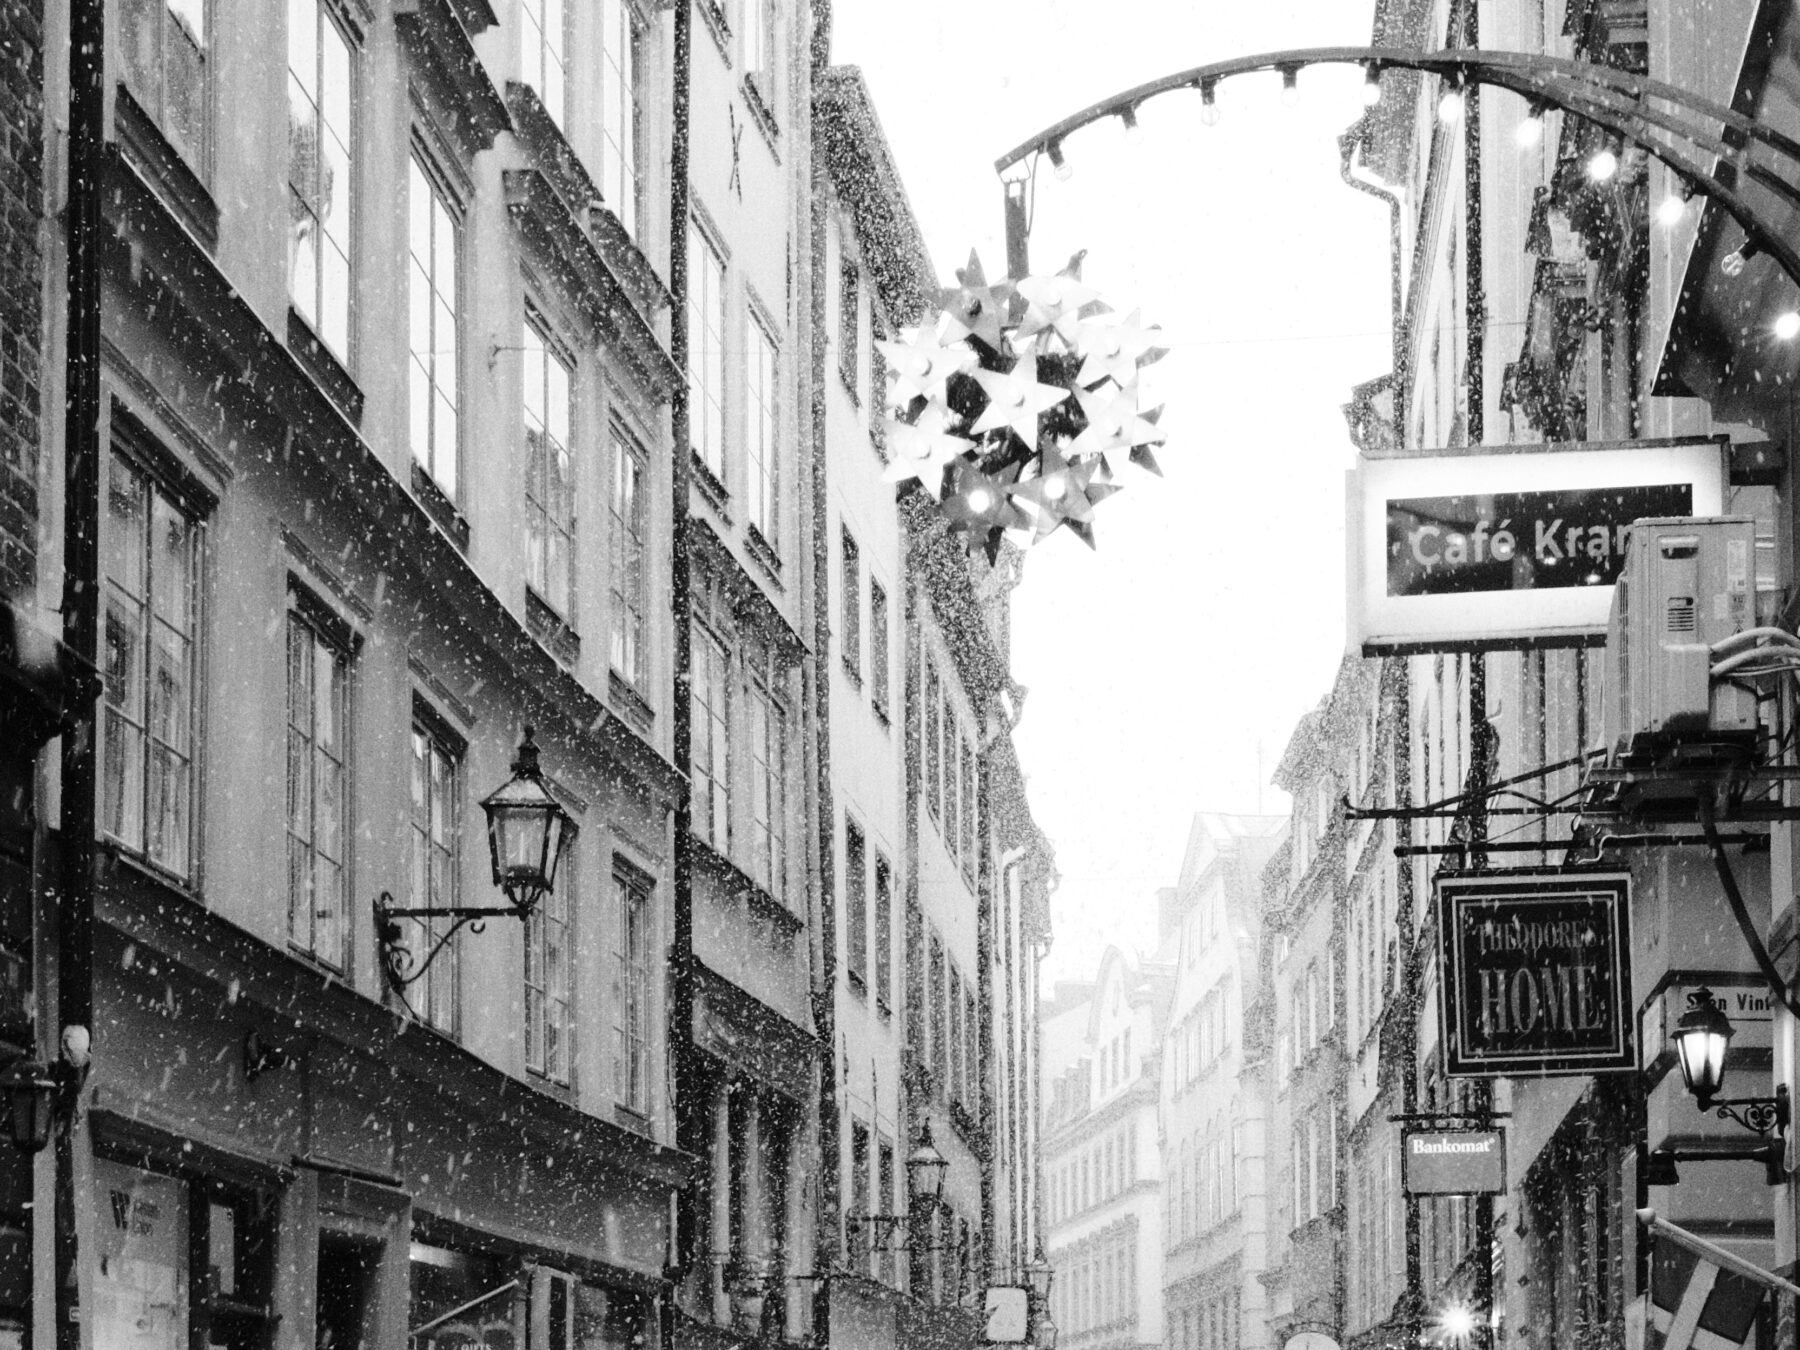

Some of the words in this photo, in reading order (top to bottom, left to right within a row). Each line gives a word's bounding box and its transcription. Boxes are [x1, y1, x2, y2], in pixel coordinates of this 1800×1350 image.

[1409, 519, 1516, 566] Café
[1469, 966, 1604, 1035] HOME
[1413, 1138, 1490, 1154] Bankomat
